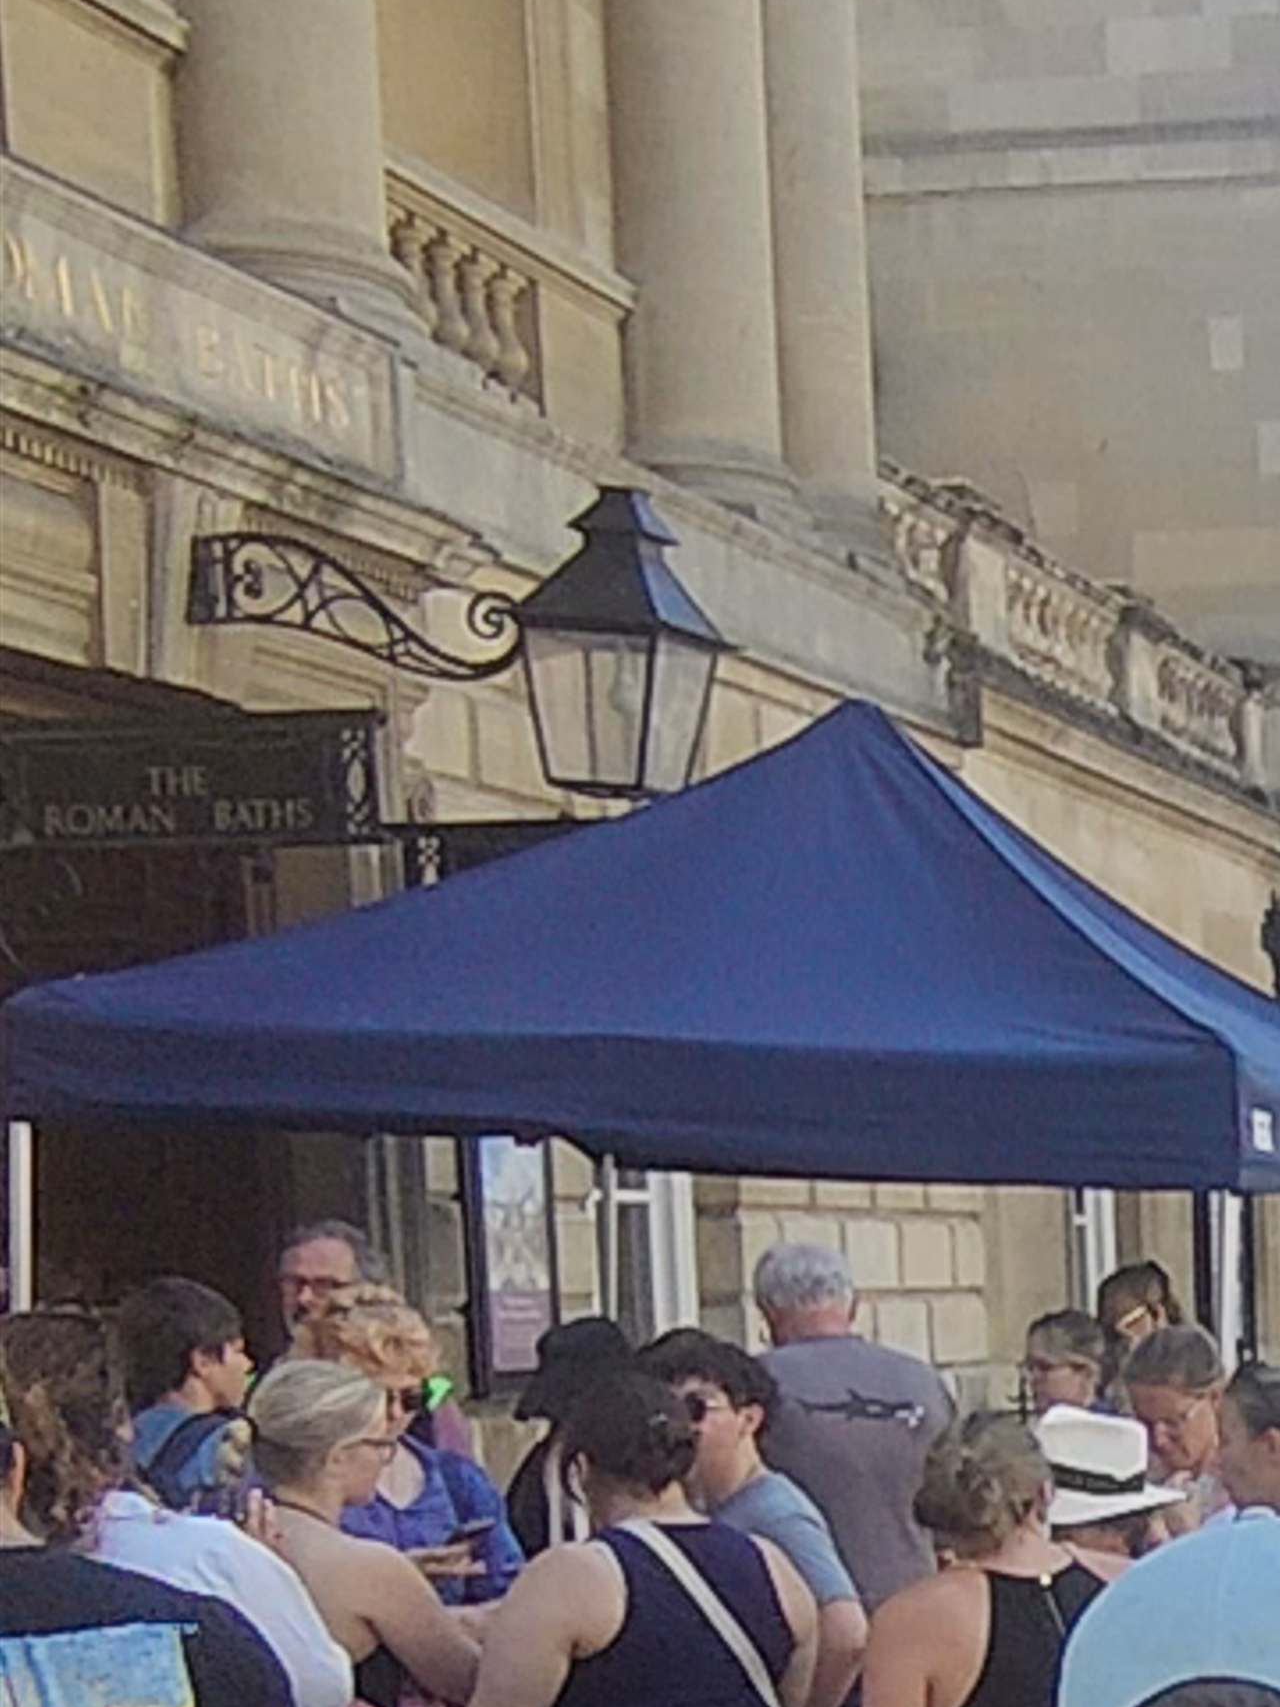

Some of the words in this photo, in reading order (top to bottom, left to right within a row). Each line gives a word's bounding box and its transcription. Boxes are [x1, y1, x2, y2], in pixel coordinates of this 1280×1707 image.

[147, 765, 208, 795] THE
[43, 804, 176, 836] ROMAN
[213, 797, 315, 832] BATHS
